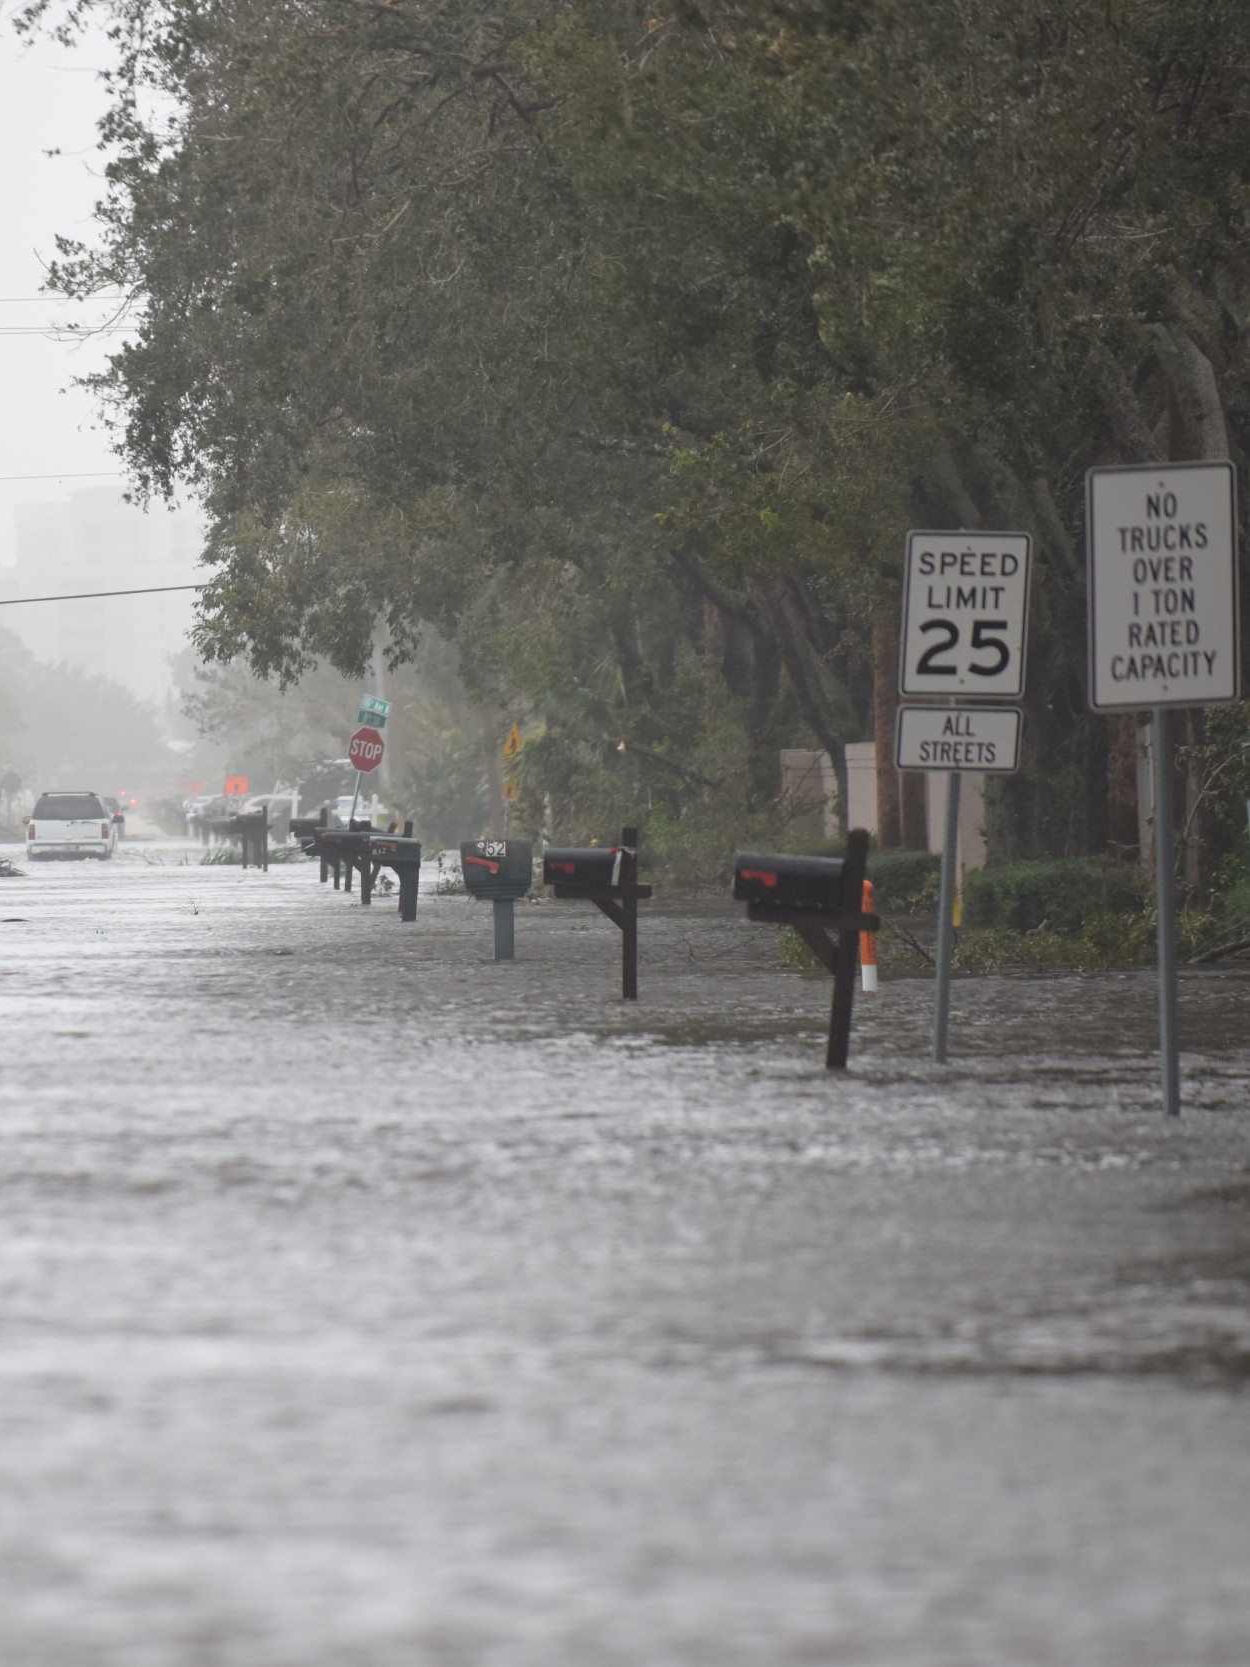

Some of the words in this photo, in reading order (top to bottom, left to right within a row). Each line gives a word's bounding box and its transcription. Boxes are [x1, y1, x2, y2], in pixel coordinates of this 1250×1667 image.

[1146, 492, 1177, 518] NO
[1118, 523, 1208, 552] TRUCKS
[918, 552, 1018, 576] SPEED
[1133, 556, 1193, 584] OVER
[927, 586, 1005, 609] LIMIT
[1152, 588, 1195, 614] TON
[1128, 620, 1199, 648] RATED
[916, 619, 1010, 676] 25
[1111, 651, 1216, 681] CAPACITY
[942, 715, 975, 736] ALL
[351, 739, 382, 760] STOP
[919, 741, 996, 763] STREETS
